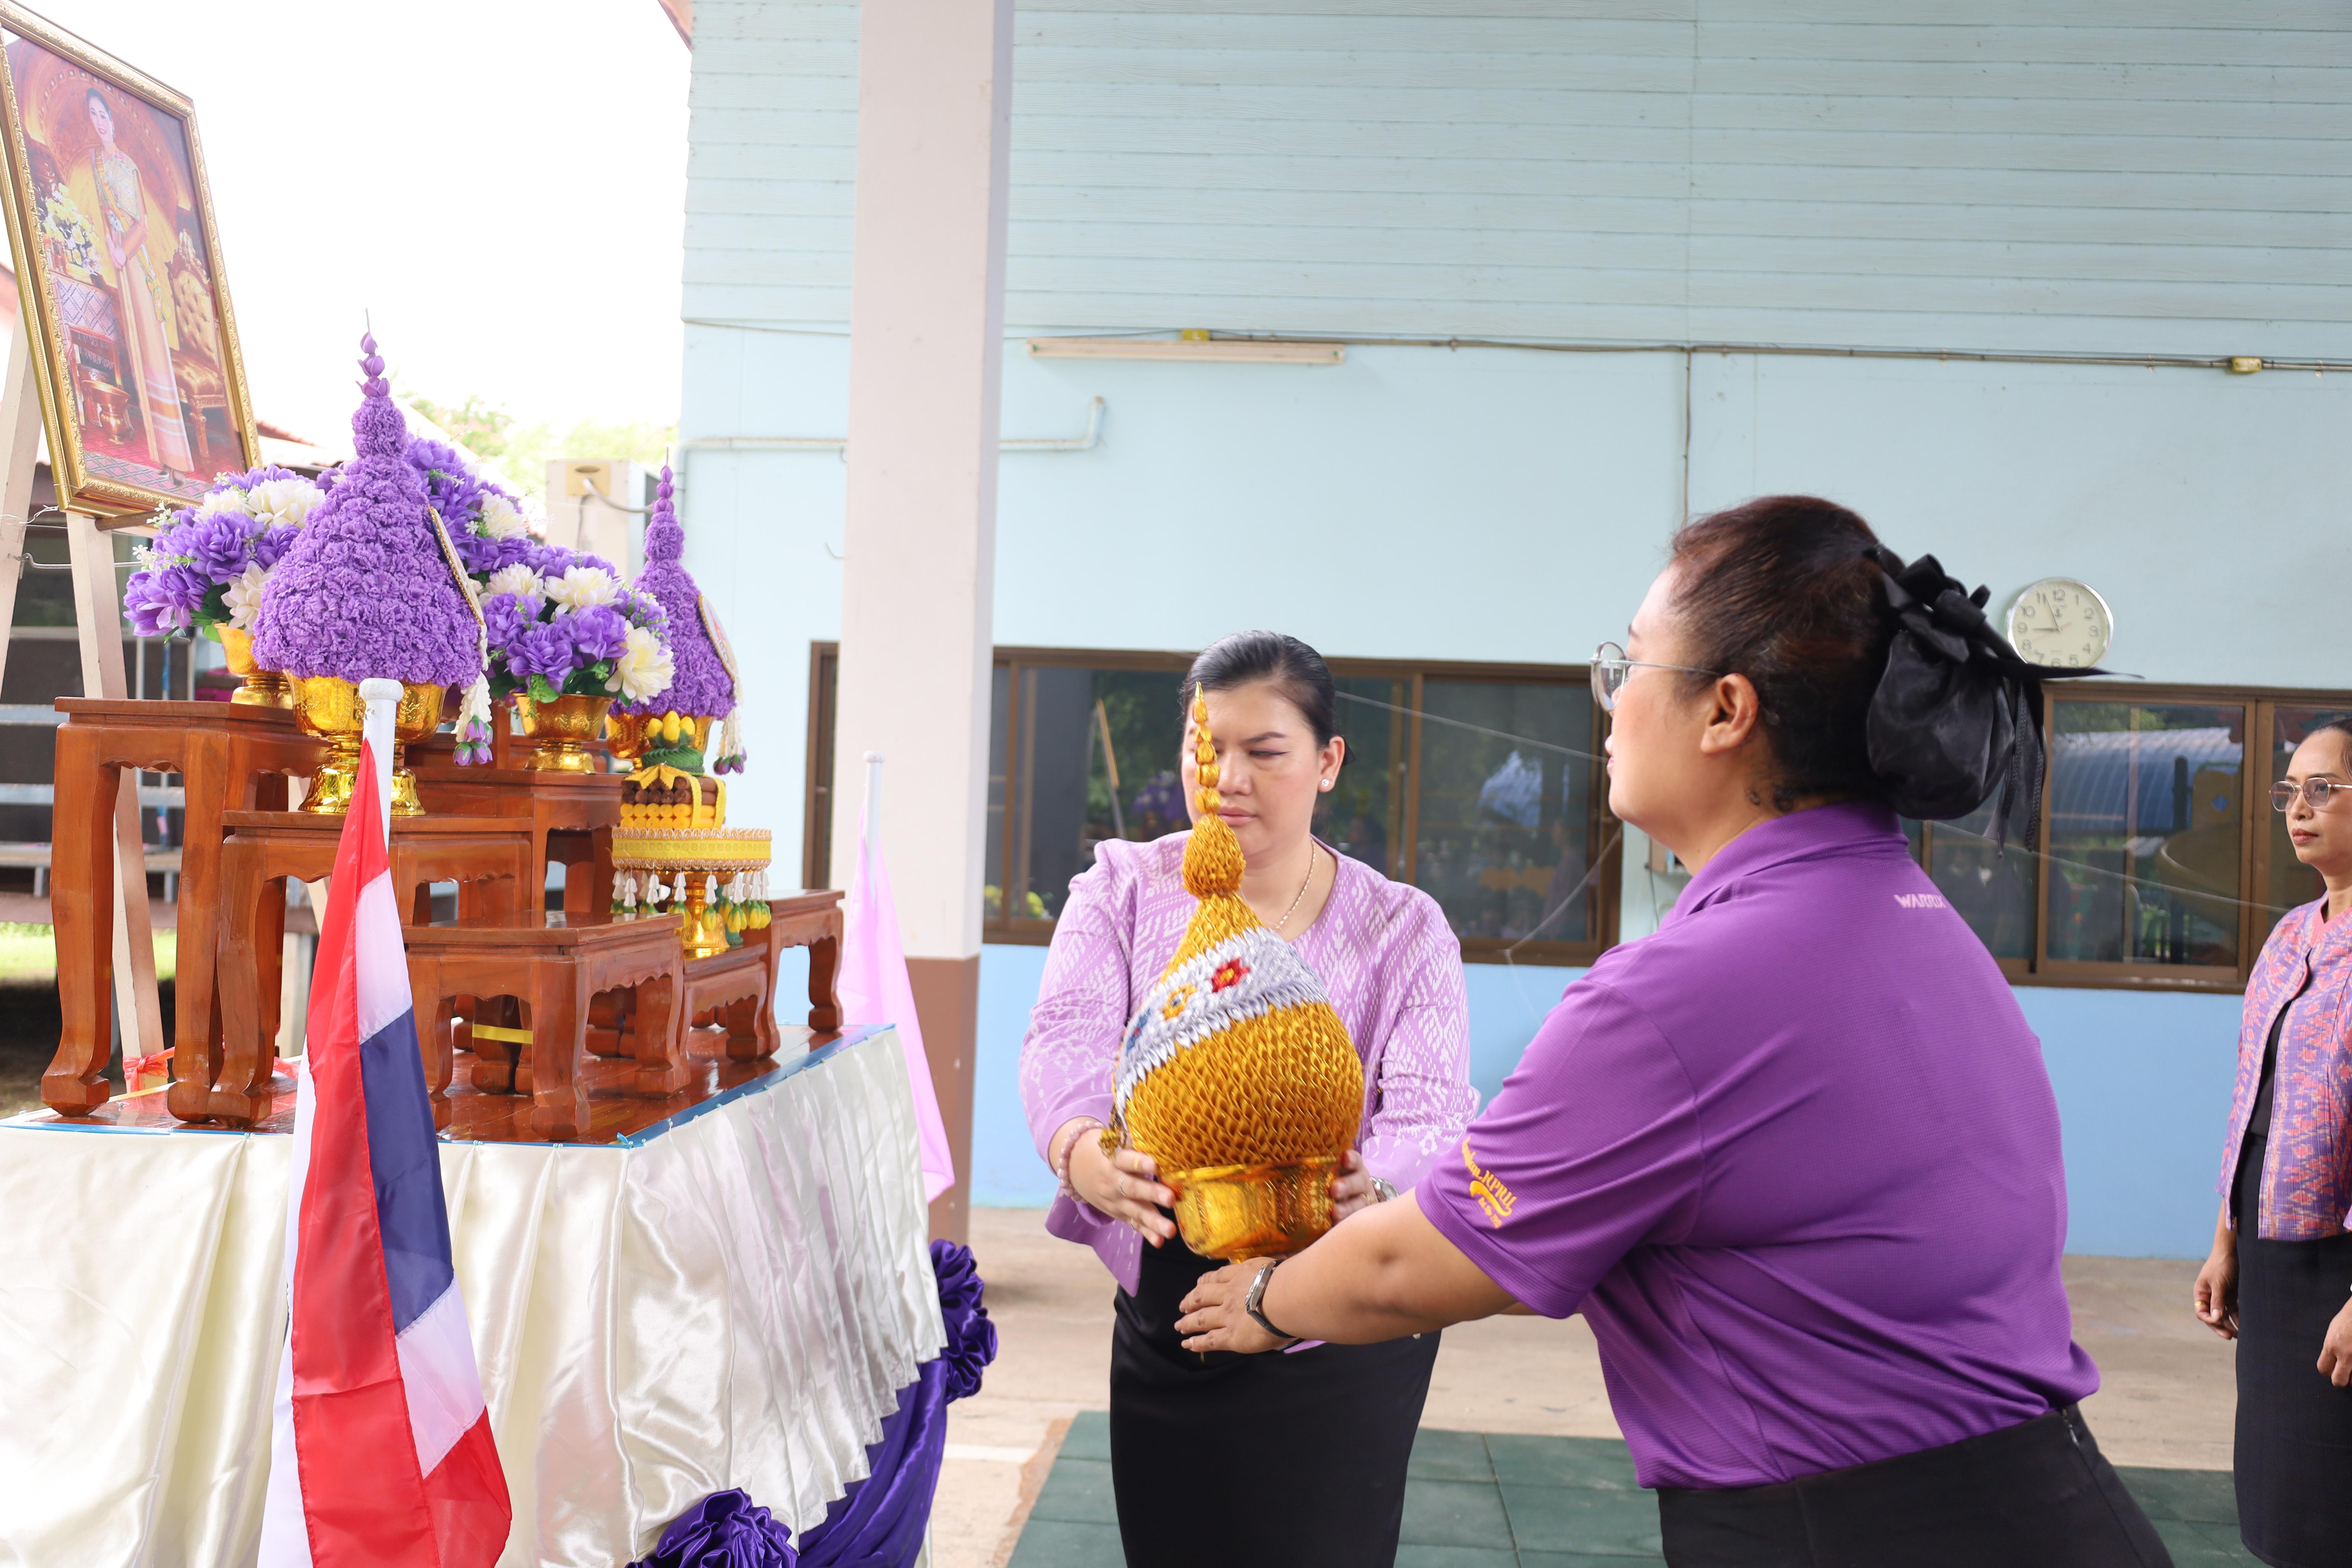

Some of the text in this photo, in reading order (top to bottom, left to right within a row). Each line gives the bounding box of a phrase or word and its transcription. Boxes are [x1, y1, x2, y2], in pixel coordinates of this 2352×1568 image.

[2036, 590, 2047, 604] 11
[2053, 589, 2065, 600] 12
[2075, 594, 2079, 605] 1
[2020, 604, 2035, 617] 10
[2084, 607, 2094, 619] 2
[2018, 622, 2027, 633] 9
[2089, 625, 2099, 637] 3
[2022, 639, 2032, 651] 8
[2083, 643, 2091, 654] 4
[2035, 649, 2044, 664] 7
[2069, 655, 2079, 668] 5
[2052, 658, 2061, 668] 6
[1894, 893, 1946, 908] WARRIX
